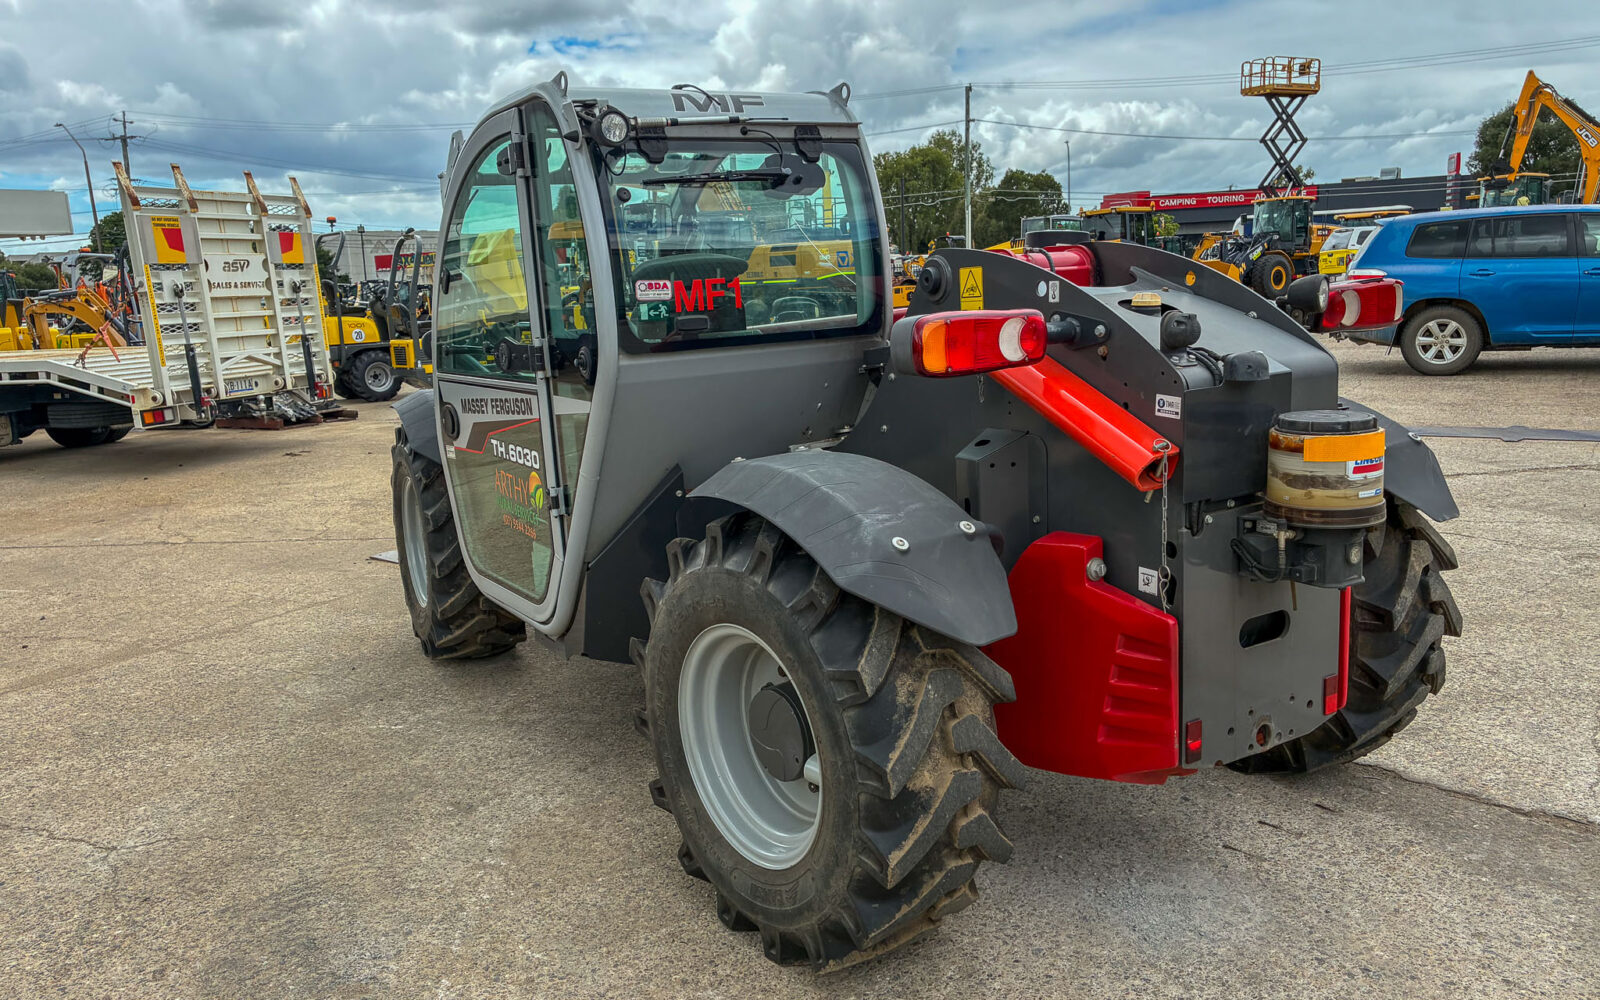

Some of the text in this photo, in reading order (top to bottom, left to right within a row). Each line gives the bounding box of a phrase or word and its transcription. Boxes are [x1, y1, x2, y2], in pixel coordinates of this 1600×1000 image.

[671, 93, 764, 113] MF
[1576, 127, 1599, 148] JCB
[1159, 197, 1197, 207] CAMPING
[1207, 194, 1245, 204] TOURING
[212, 280, 265, 289] SALES & SERVICE
[673, 277, 742, 313] MF1
[354, 330, 363, 340] 20
[460, 398, 534, 416] MASSEY FERGUSON
[491, 438, 540, 470] TH.6030
[495, 466, 529, 505] ARTHY
